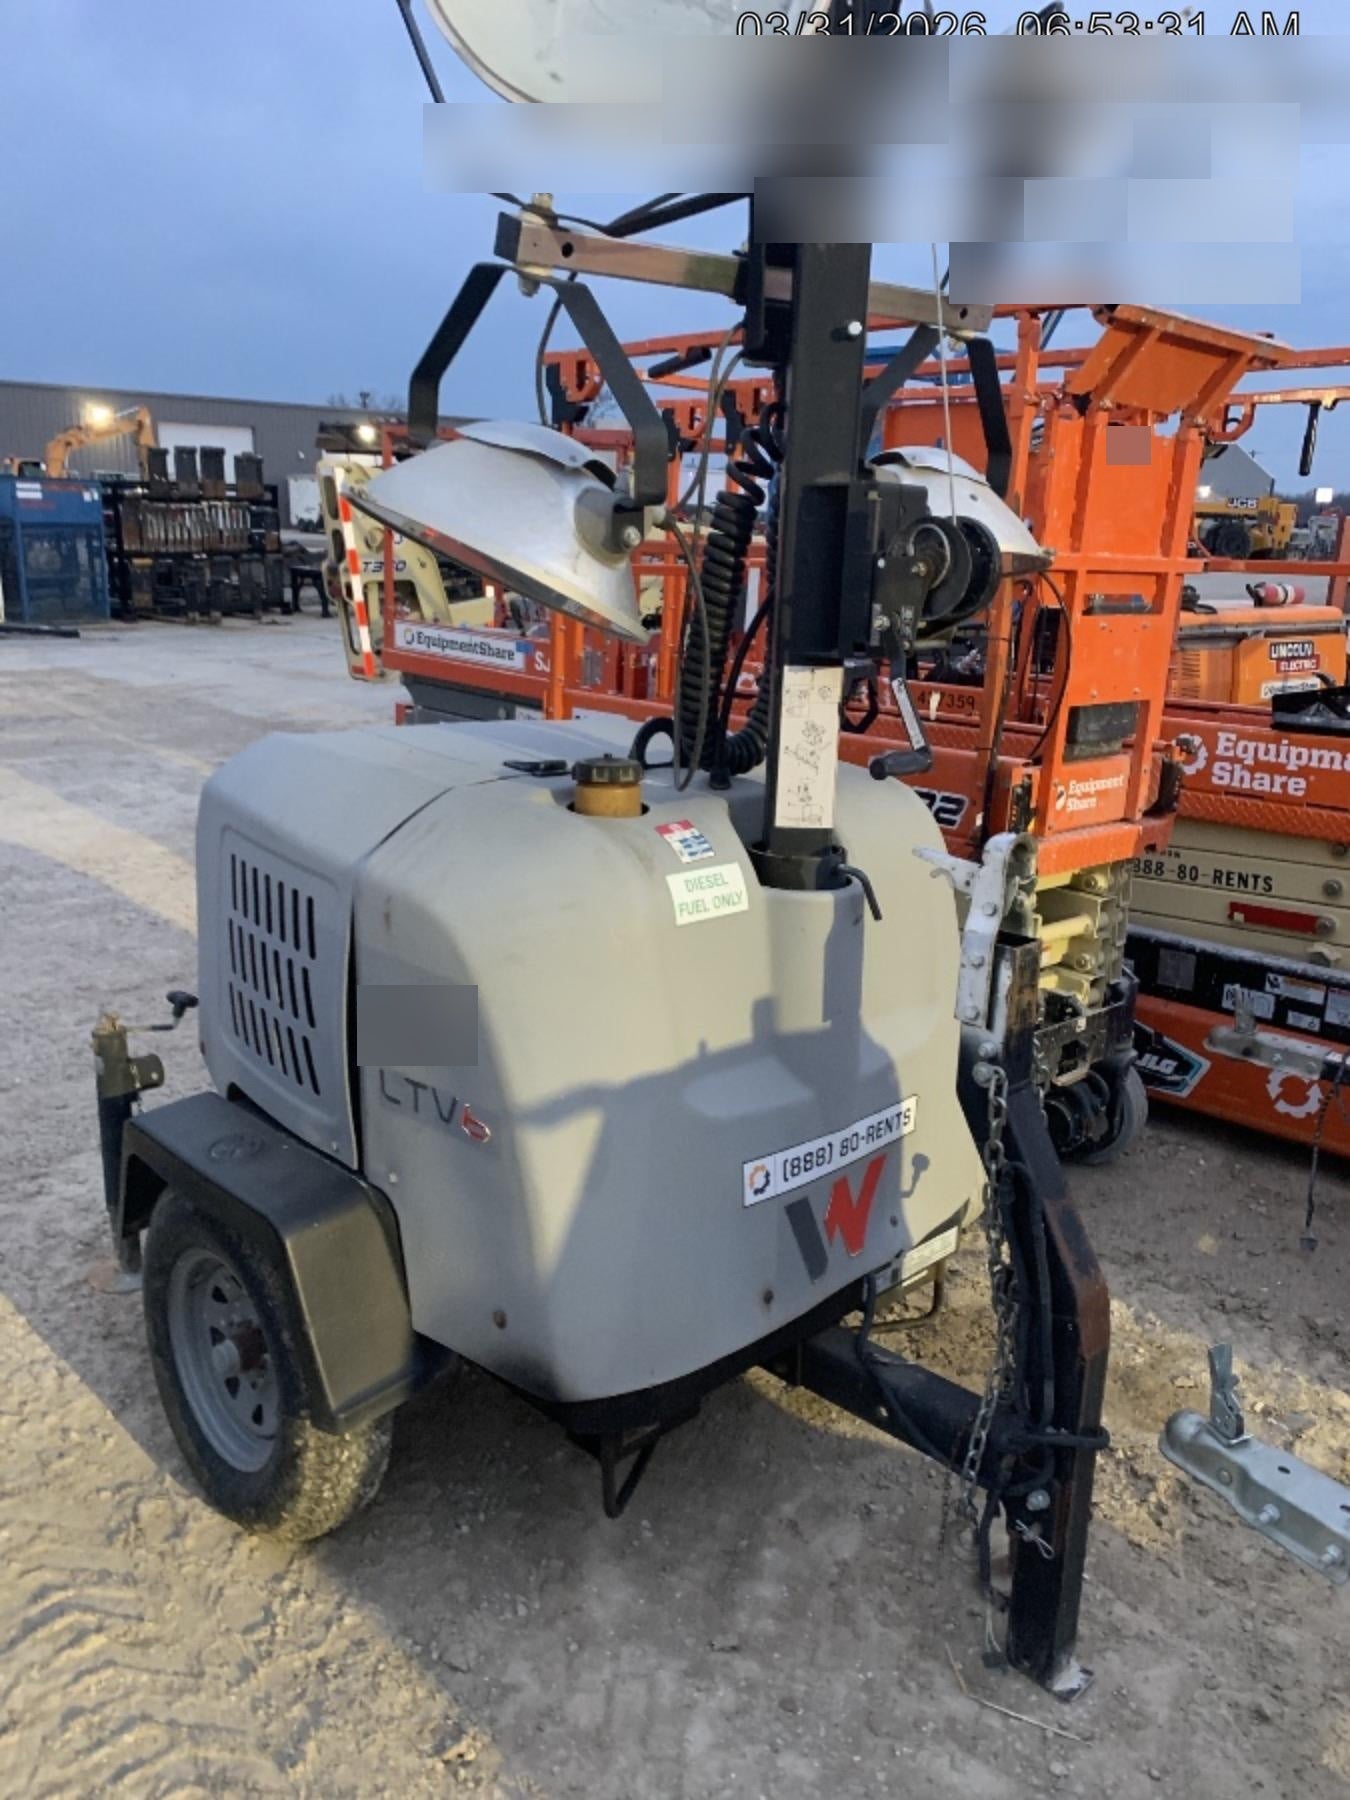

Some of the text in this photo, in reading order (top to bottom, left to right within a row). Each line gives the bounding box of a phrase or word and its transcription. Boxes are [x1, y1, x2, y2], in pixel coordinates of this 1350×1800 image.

[1227, 497, 1257, 509] JCB
[363, 560, 407, 572] T30
[415, 630, 515, 662] EquipmentShare
[1068, 775, 1124, 796] Equipment
[1211, 761, 1307, 797] Share
[1065, 797, 1097, 812] Share
[685, 872, 729, 892] DIESEL
[678, 891, 743, 917] FUEL ONLY
[1135, 1053, 1178, 1075] JLG
[782, 1107, 912, 1183] (888) 80-RENTS
